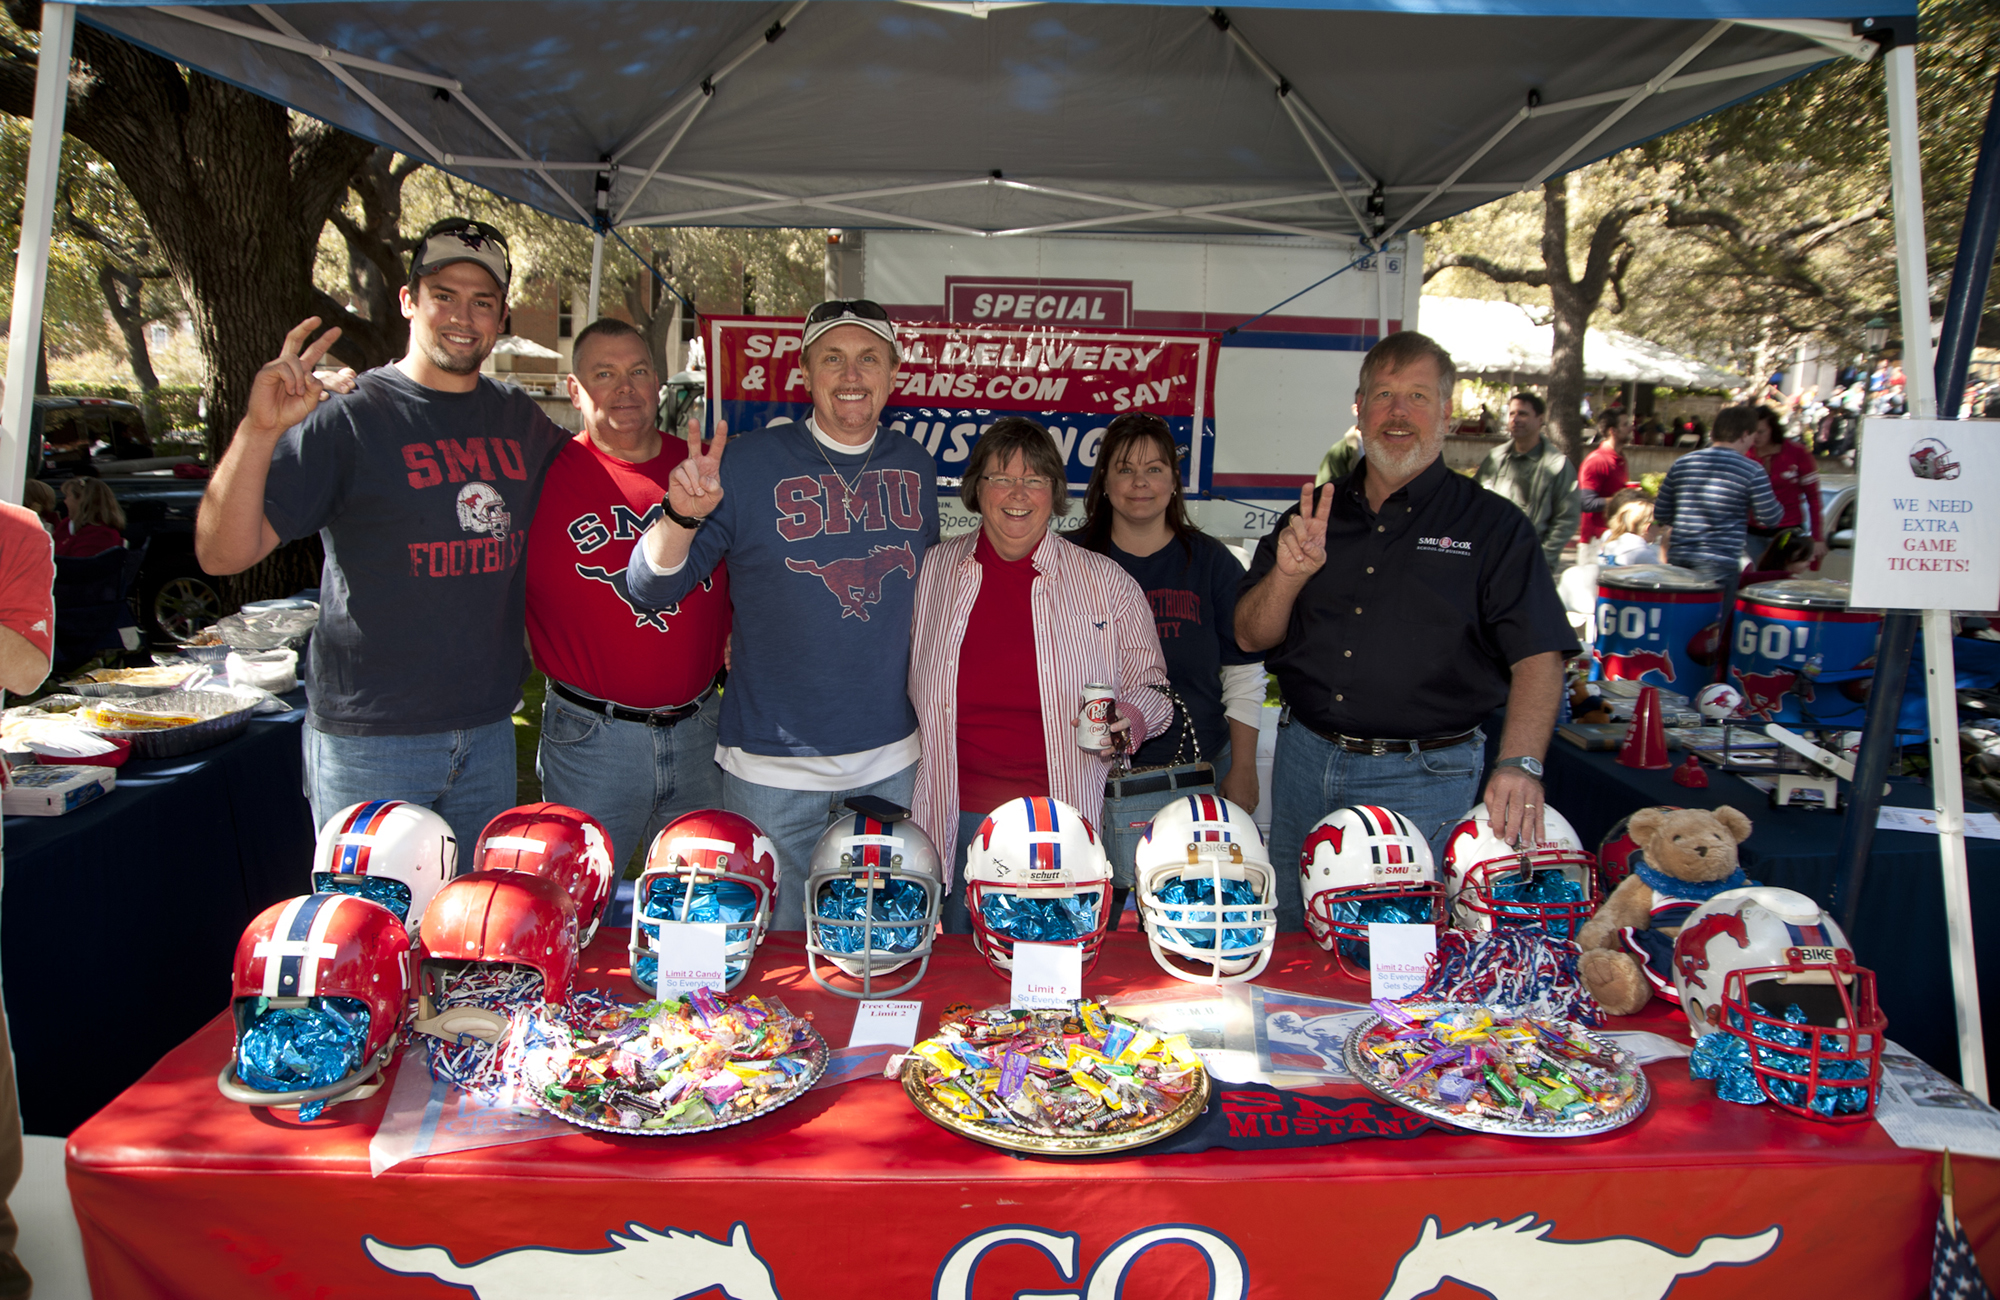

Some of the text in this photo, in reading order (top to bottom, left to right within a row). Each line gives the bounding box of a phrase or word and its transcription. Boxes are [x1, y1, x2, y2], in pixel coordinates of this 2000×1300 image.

[972, 293, 1107, 320] SPECIAL
[744, 335, 1163, 371] SPAL DELIVERY
[741, 365, 766, 390] &
[401, 436, 527, 489] SMU
[774, 469, 924, 542] SMU
[1893, 498, 1973, 513] WE NEED
[567, 503, 664, 554] SM
[1902, 518, 1960, 532] EXTRA
[1419, 537, 1471, 549] SMU COX
[1903, 538, 1957, 552] GAME
[1887, 557, 1970, 572] TICKETS!
[1598, 603, 1662, 641] GO!
[1738, 619, 1809, 662] GO!
[1201, 844, 1228, 853] BIKE
[1536, 842, 1559, 850] SMU
[1030, 871, 1060, 879] schutt
[1385, 867, 1410, 875] SMU
[1802, 949, 1834, 961] BIKE
[1376, 963, 1396, 971] Limit
[695, 970, 722, 979] Candy
[1391, 973, 1426, 983] Everybod
[667, 979, 720, 989] So Everybody
[1028, 984, 1067, 994] Limit 2
[1383, 982, 1400, 990] Gets
[1017, 994, 1029, 1002] So
